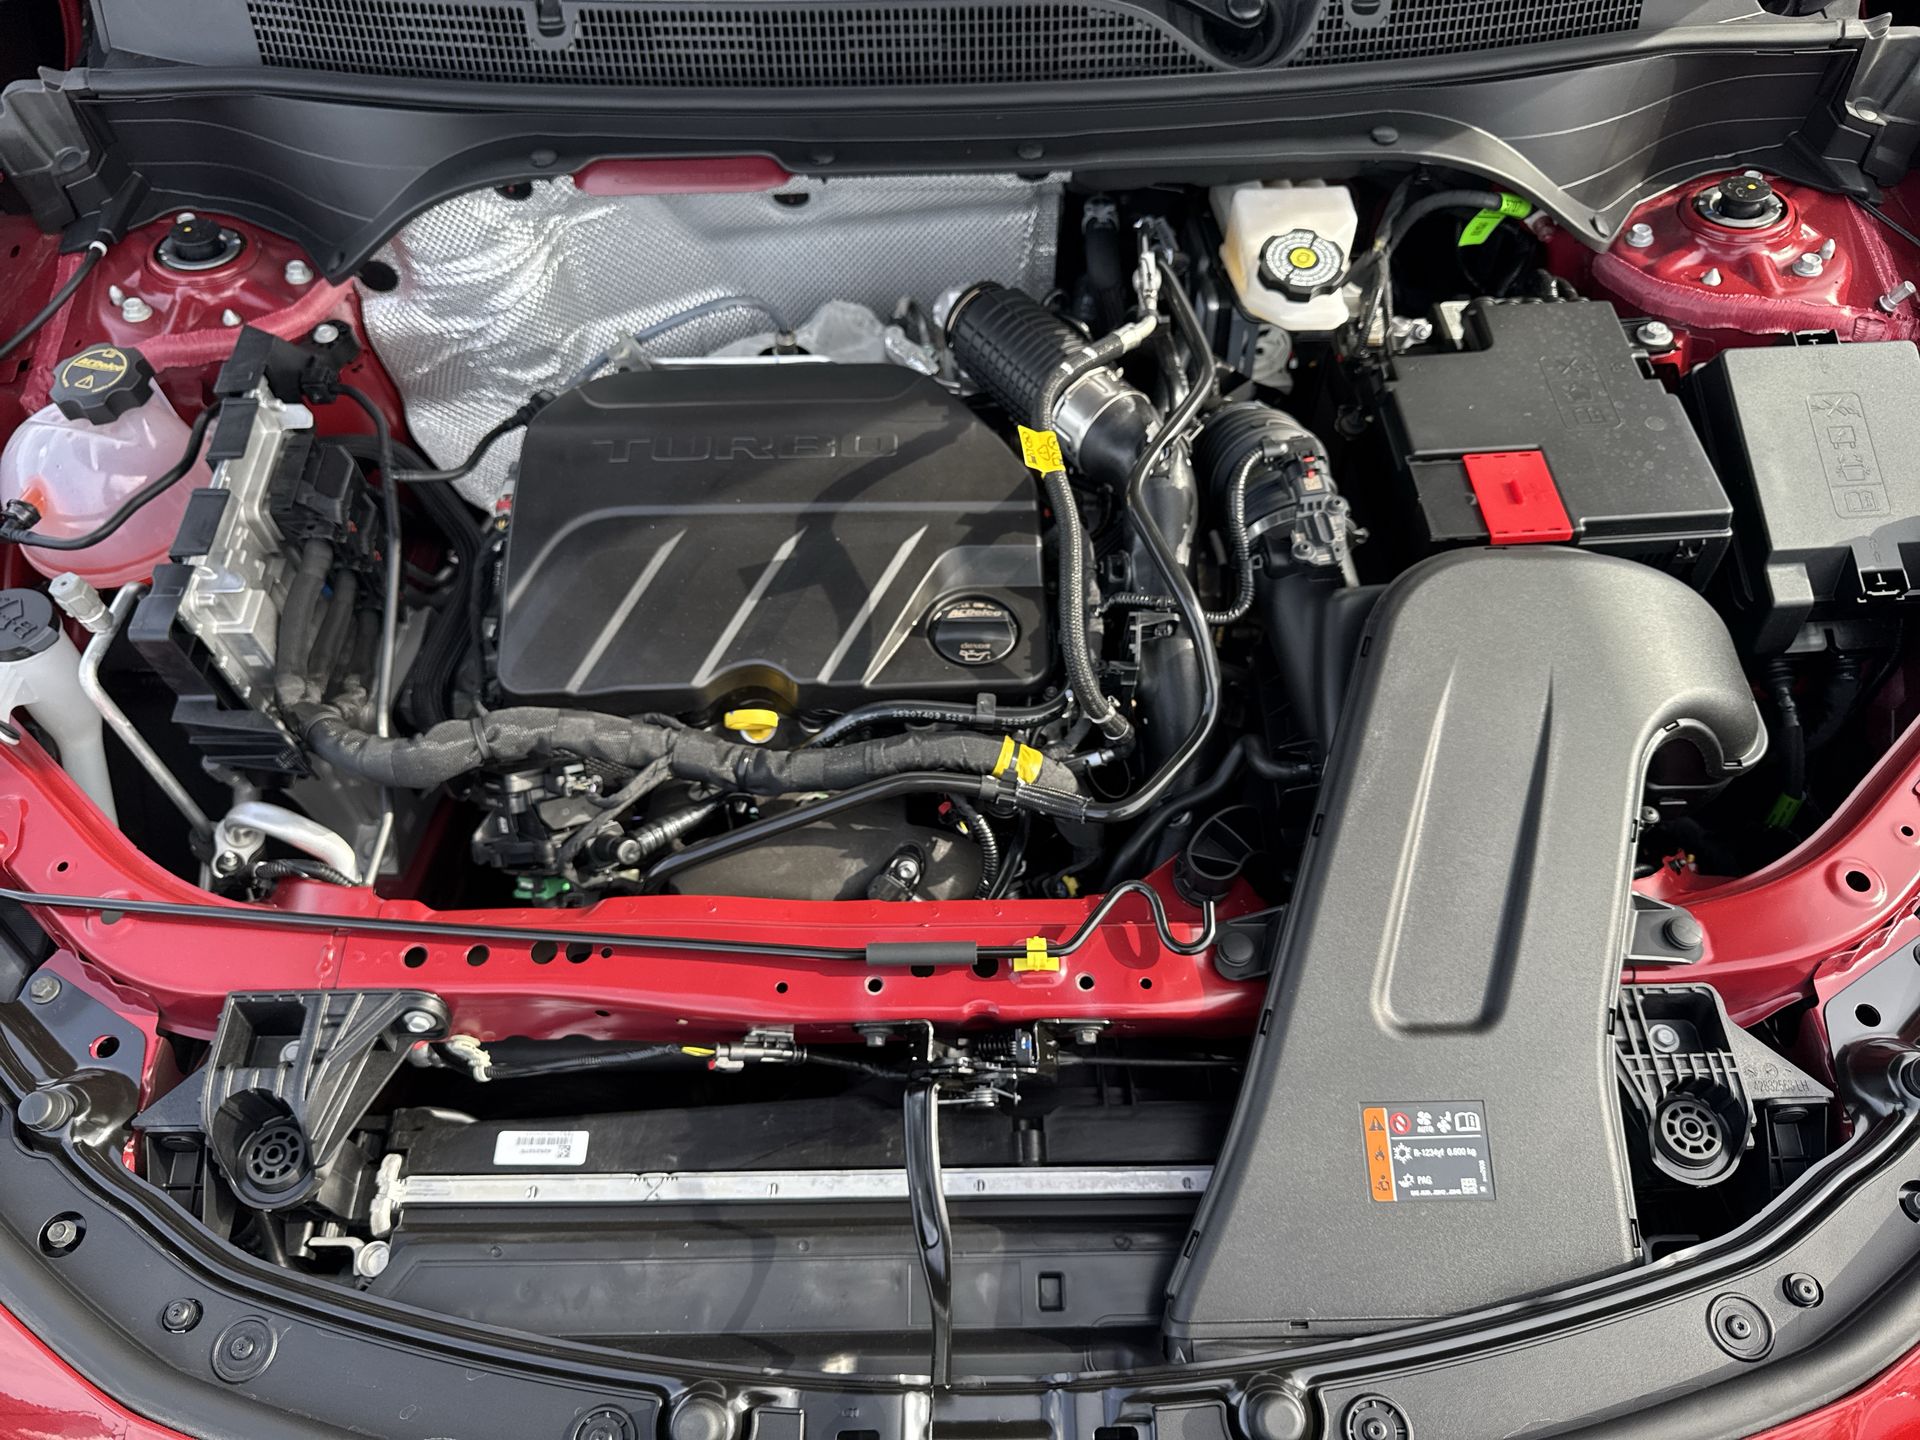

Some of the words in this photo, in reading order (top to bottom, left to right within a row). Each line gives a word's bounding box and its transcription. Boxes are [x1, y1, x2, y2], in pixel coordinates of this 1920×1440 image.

[592, 434, 898, 463] TURBO
[947, 608, 1002, 619] ACDelco
[1417, 1175, 1433, 1185] PAG
